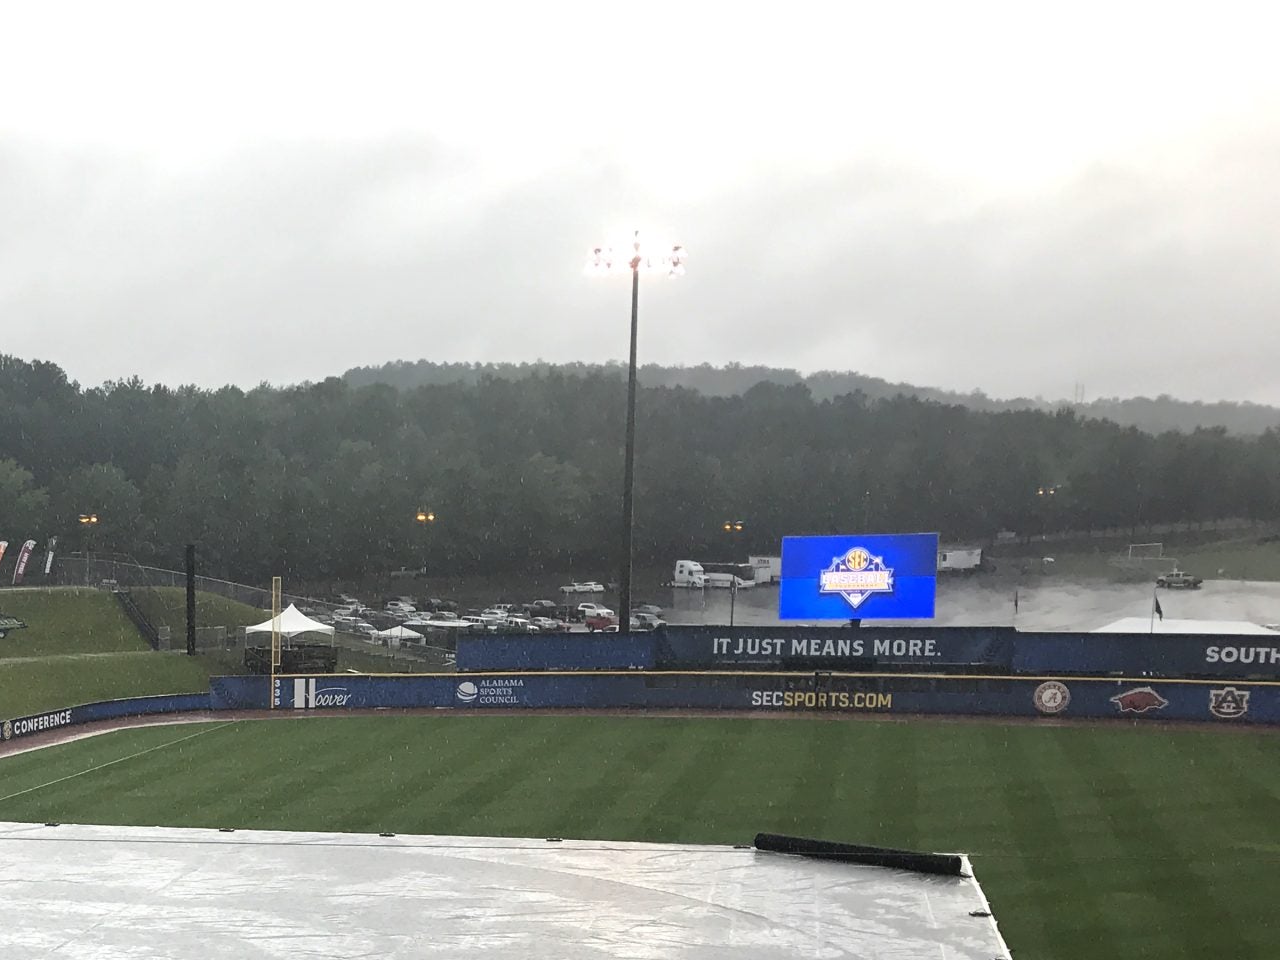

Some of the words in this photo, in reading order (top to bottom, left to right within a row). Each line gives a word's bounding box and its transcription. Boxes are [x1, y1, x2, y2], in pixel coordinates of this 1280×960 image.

[713, 638, 731, 655] IT
[734, 638, 786, 656] JUST
[791, 639, 864, 657] MEANS
[873, 639, 942, 657] MORE.
[480, 679, 524, 687] ALABAMA
[480, 687, 513, 695] SPORTS
[291, 678, 352, 708] Hoover
[480, 696, 519, 704] COUNCIL
[751, 691, 892, 708] SECSPORTS.COM
[14, 711, 72, 735] CONFERENCE
